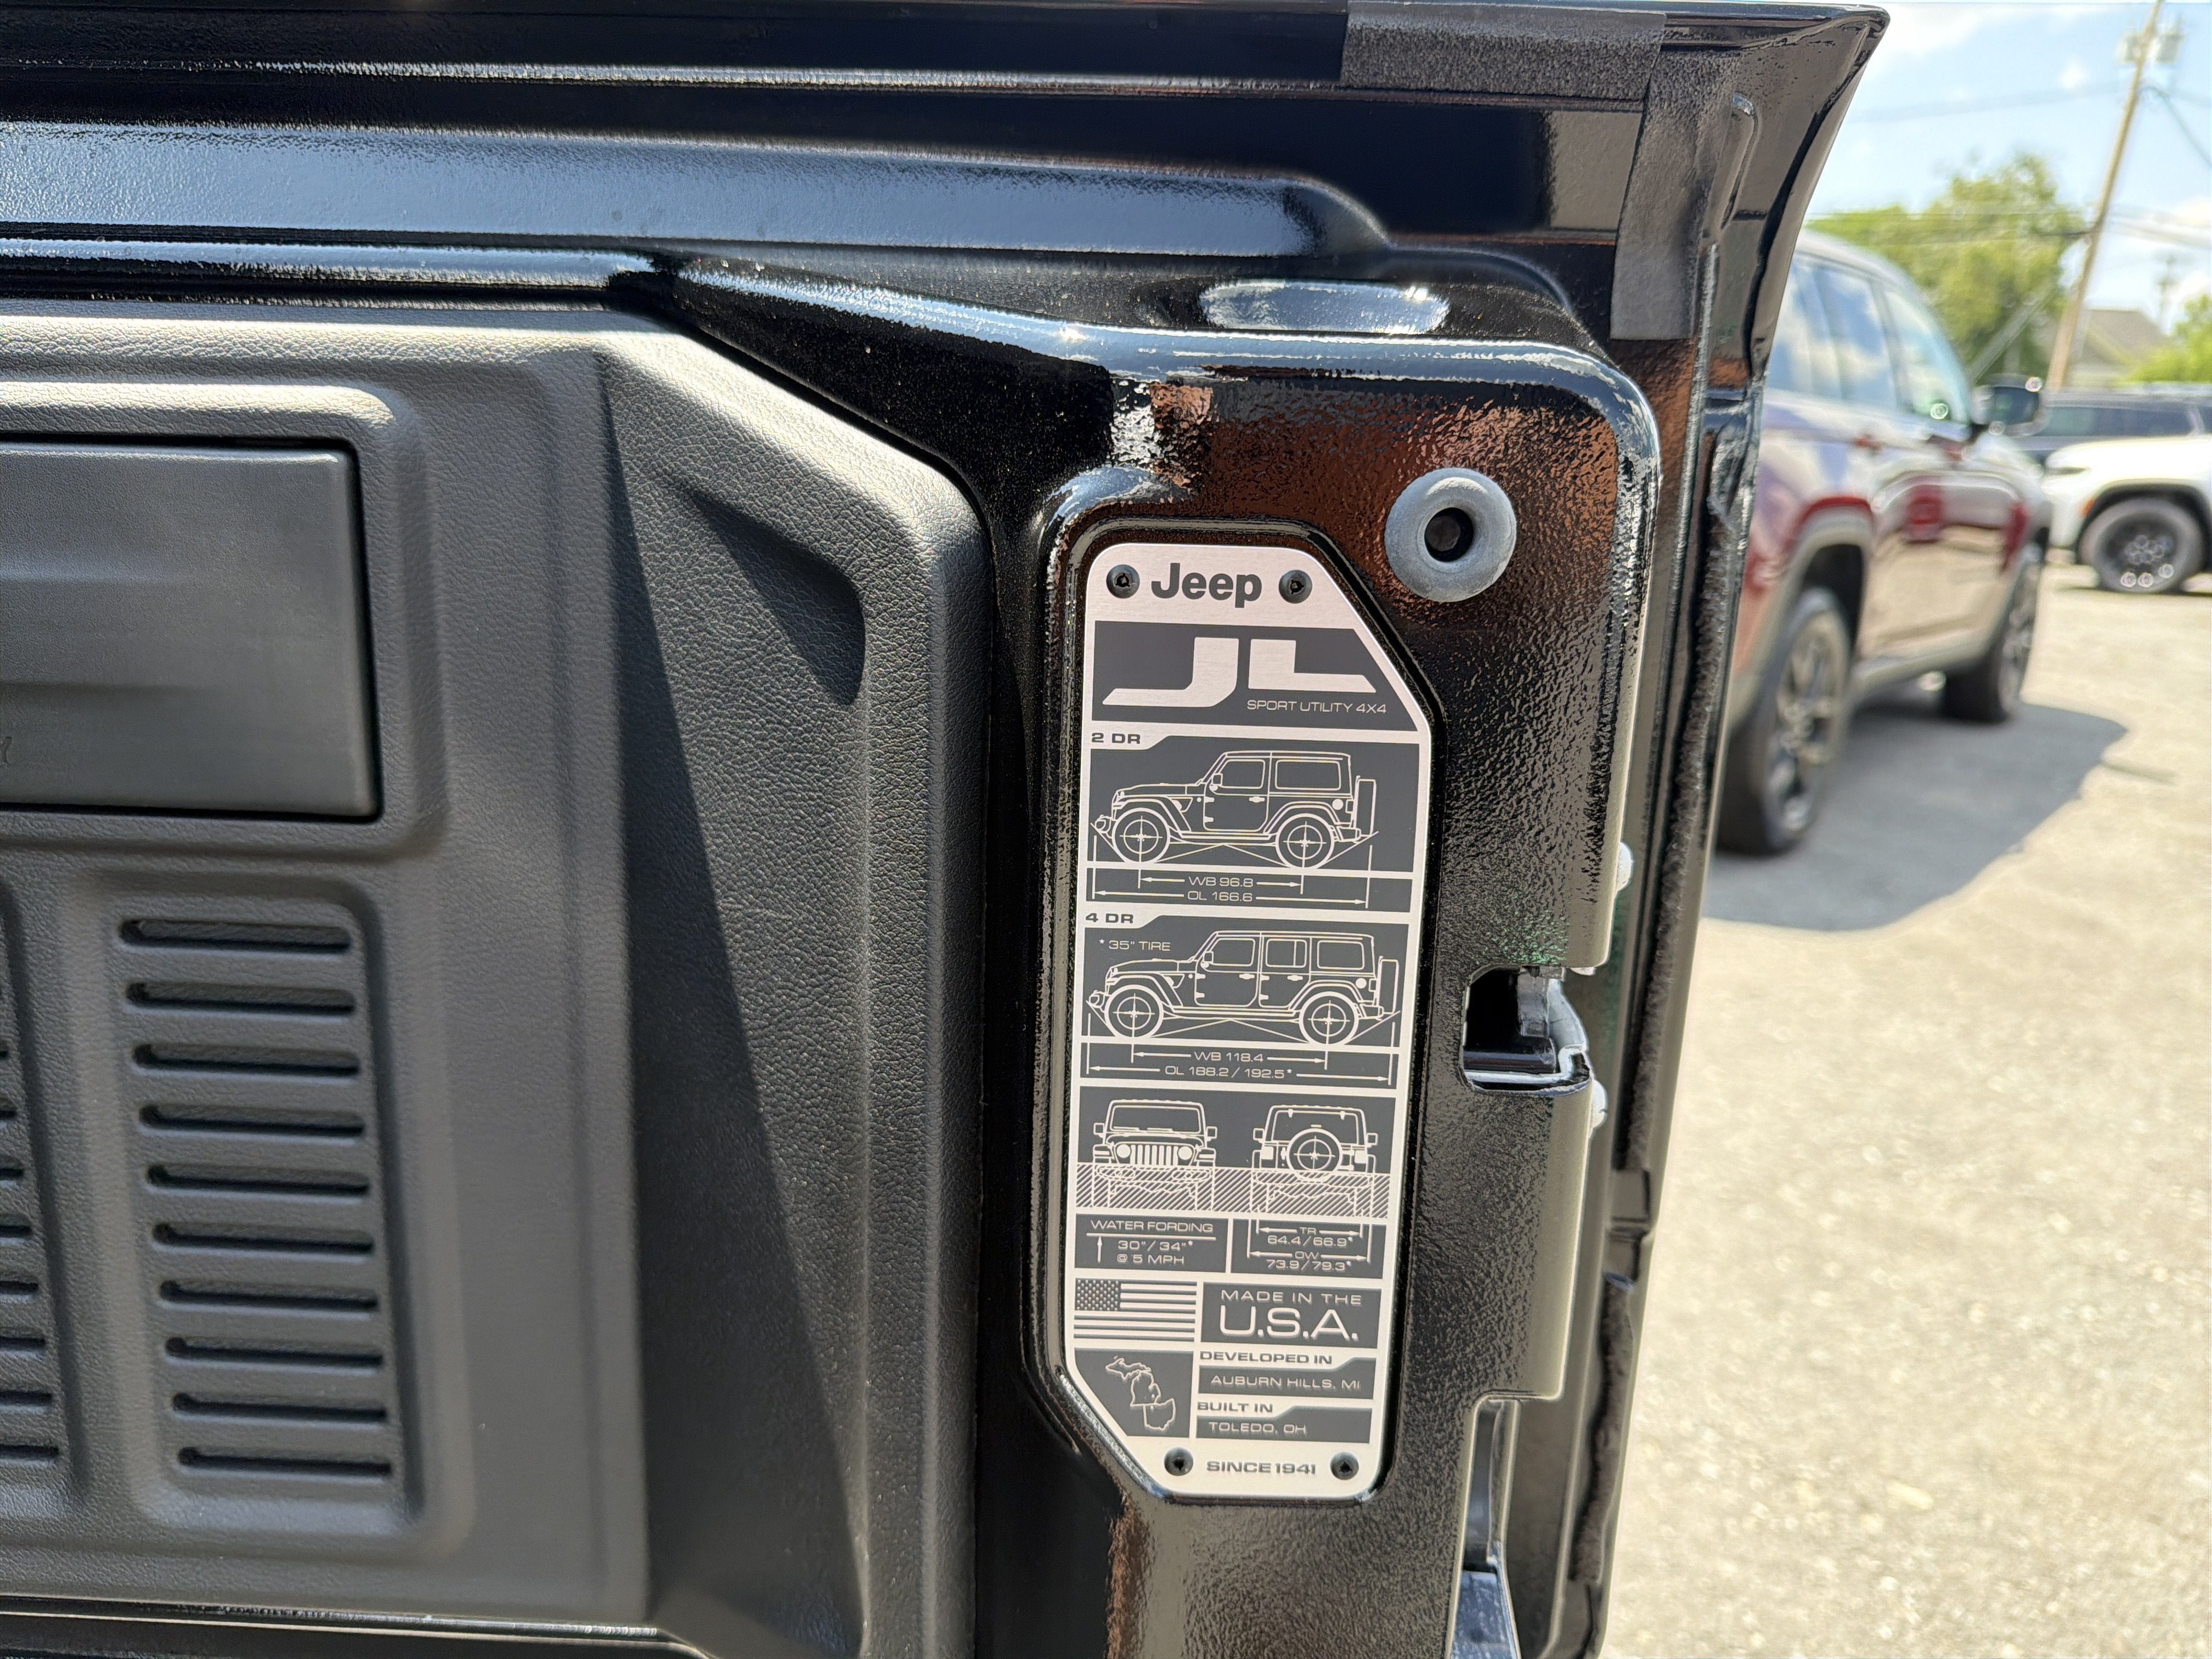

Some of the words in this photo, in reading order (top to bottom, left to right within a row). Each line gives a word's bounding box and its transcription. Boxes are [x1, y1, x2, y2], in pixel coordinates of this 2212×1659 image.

[1152, 563, 1262, 608] Jeep
[1102, 636, 1376, 708] JL
[1247, 699, 1297, 711] SPORT
[1300, 702, 1353, 713] UTILITY
[1091, 732, 1104, 744] 2
[1111, 733, 1141, 745] DR
[1188, 876, 1216, 886] WB
[1219, 877, 1254, 888] 96.8
[1187, 890, 1207, 900] OL
[1211, 891, 1253, 902] 166.6
[1085, 913, 1099, 923] 4
[1105, 913, 1134, 923] DR
[1138, 941, 1171, 951] TIRE
[1194, 1051, 1221, 1062] WB
[1226, 1052, 1264, 1063] 118.4
[1165, 1065, 1184, 1075] OL
[1189, 1066, 1229, 1077] 188.2
[1090, 1220, 1144, 1231] WATER
[1147, 1221, 1214, 1233] FORDING
[1299, 1227, 1317, 1235] TR
[1116, 1254, 1128, 1263] @
[1132, 1254, 1143, 1263] 5
[1148, 1255, 1185, 1265] MPH
[1294, 1251, 1319, 1260] OW
[1221, 1289, 1284, 1304] MADE
[1291, 1293, 1312, 1305] IN
[1321, 1294, 1362, 1306] THE
[1219, 1305, 1359, 1342] U.S.A.
[1200, 1350, 1310, 1364] DEVELOPED
[1314, 1355, 1333, 1364] IN
[1211, 1375, 1282, 1389] AUBURN
[1287, 1378, 1336, 1390] HILLS,
[1341, 1379, 1361, 1390] MI
[1197, 1401, 1249, 1413] BUILT
[1254, 1403, 1273, 1413] IN
[1209, 1421, 1279, 1435] TOLEDO,
[1283, 1424, 1308, 1435] OH
[1206, 1461, 1272, 1473] SINCE
[1274, 1463, 1316, 1474] 1941
